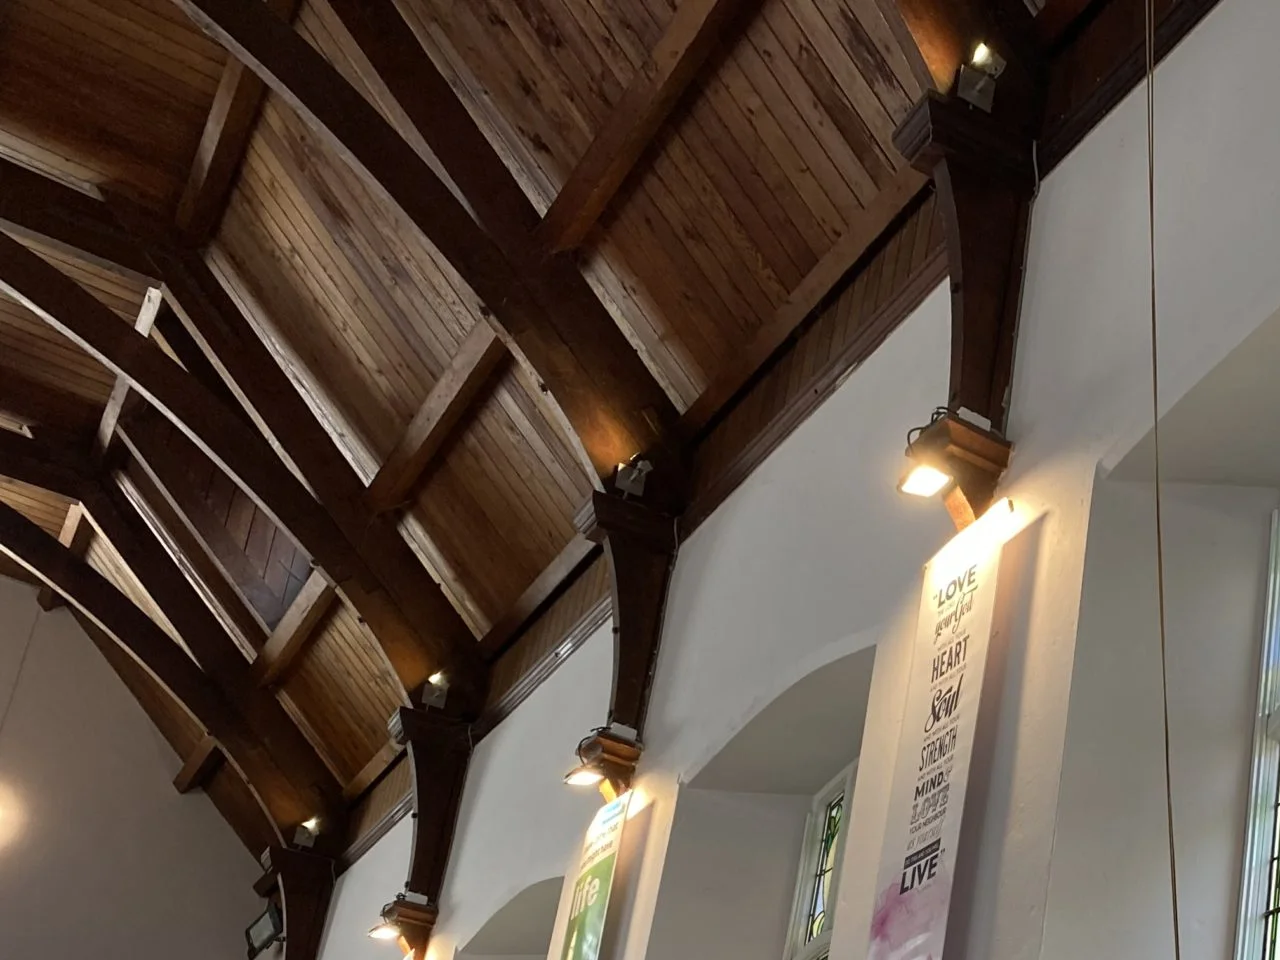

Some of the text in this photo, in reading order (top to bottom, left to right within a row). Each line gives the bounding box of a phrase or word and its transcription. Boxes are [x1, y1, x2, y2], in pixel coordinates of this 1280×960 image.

[931, 634, 970, 684] HEART
[924, 673, 964, 733] Soul
[919, 724, 958, 772] STRENGTH
[910, 783, 950, 826] LOVE
[570, 875, 600, 921] life
